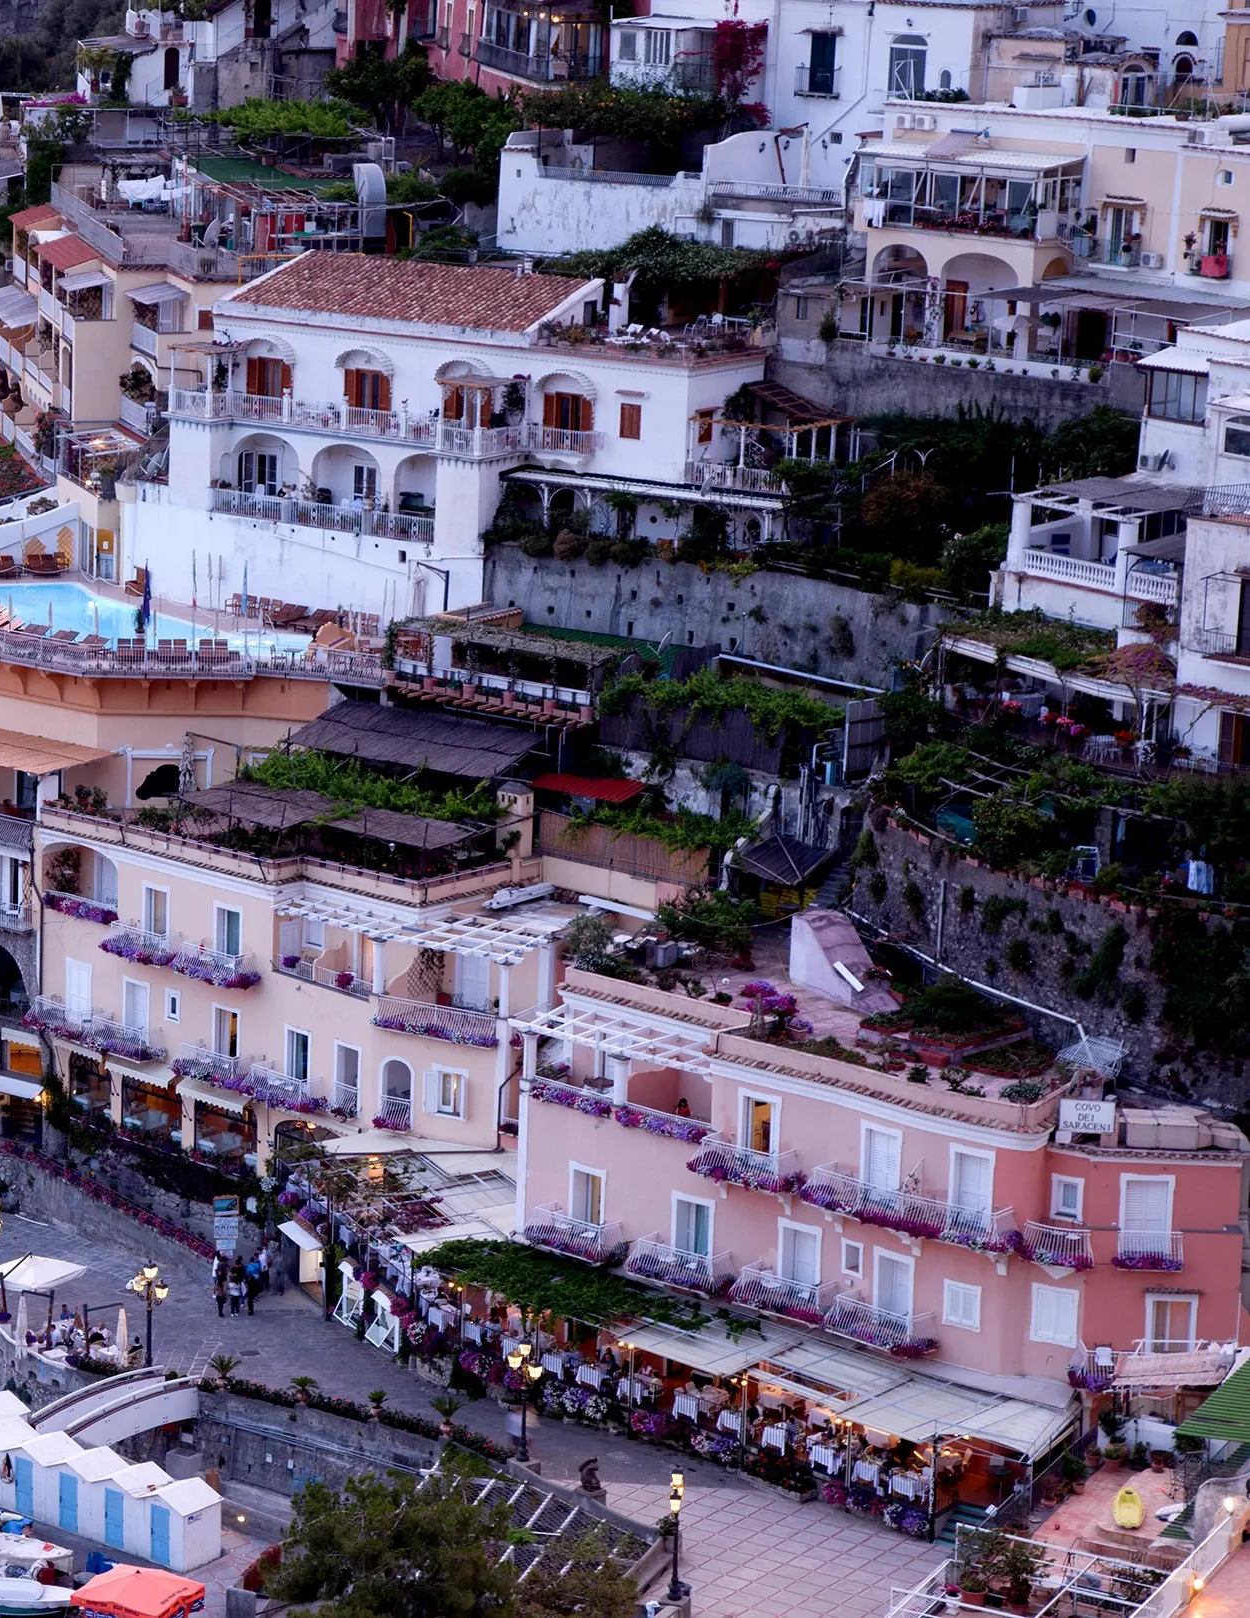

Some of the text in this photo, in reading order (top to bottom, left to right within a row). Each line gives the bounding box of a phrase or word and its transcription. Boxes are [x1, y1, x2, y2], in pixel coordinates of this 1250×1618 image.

[1075, 1102, 1102, 1112] COVO
[1078, 1113, 1095, 1122] DEI
[1062, 1121, 1111, 1131] SARACENI
